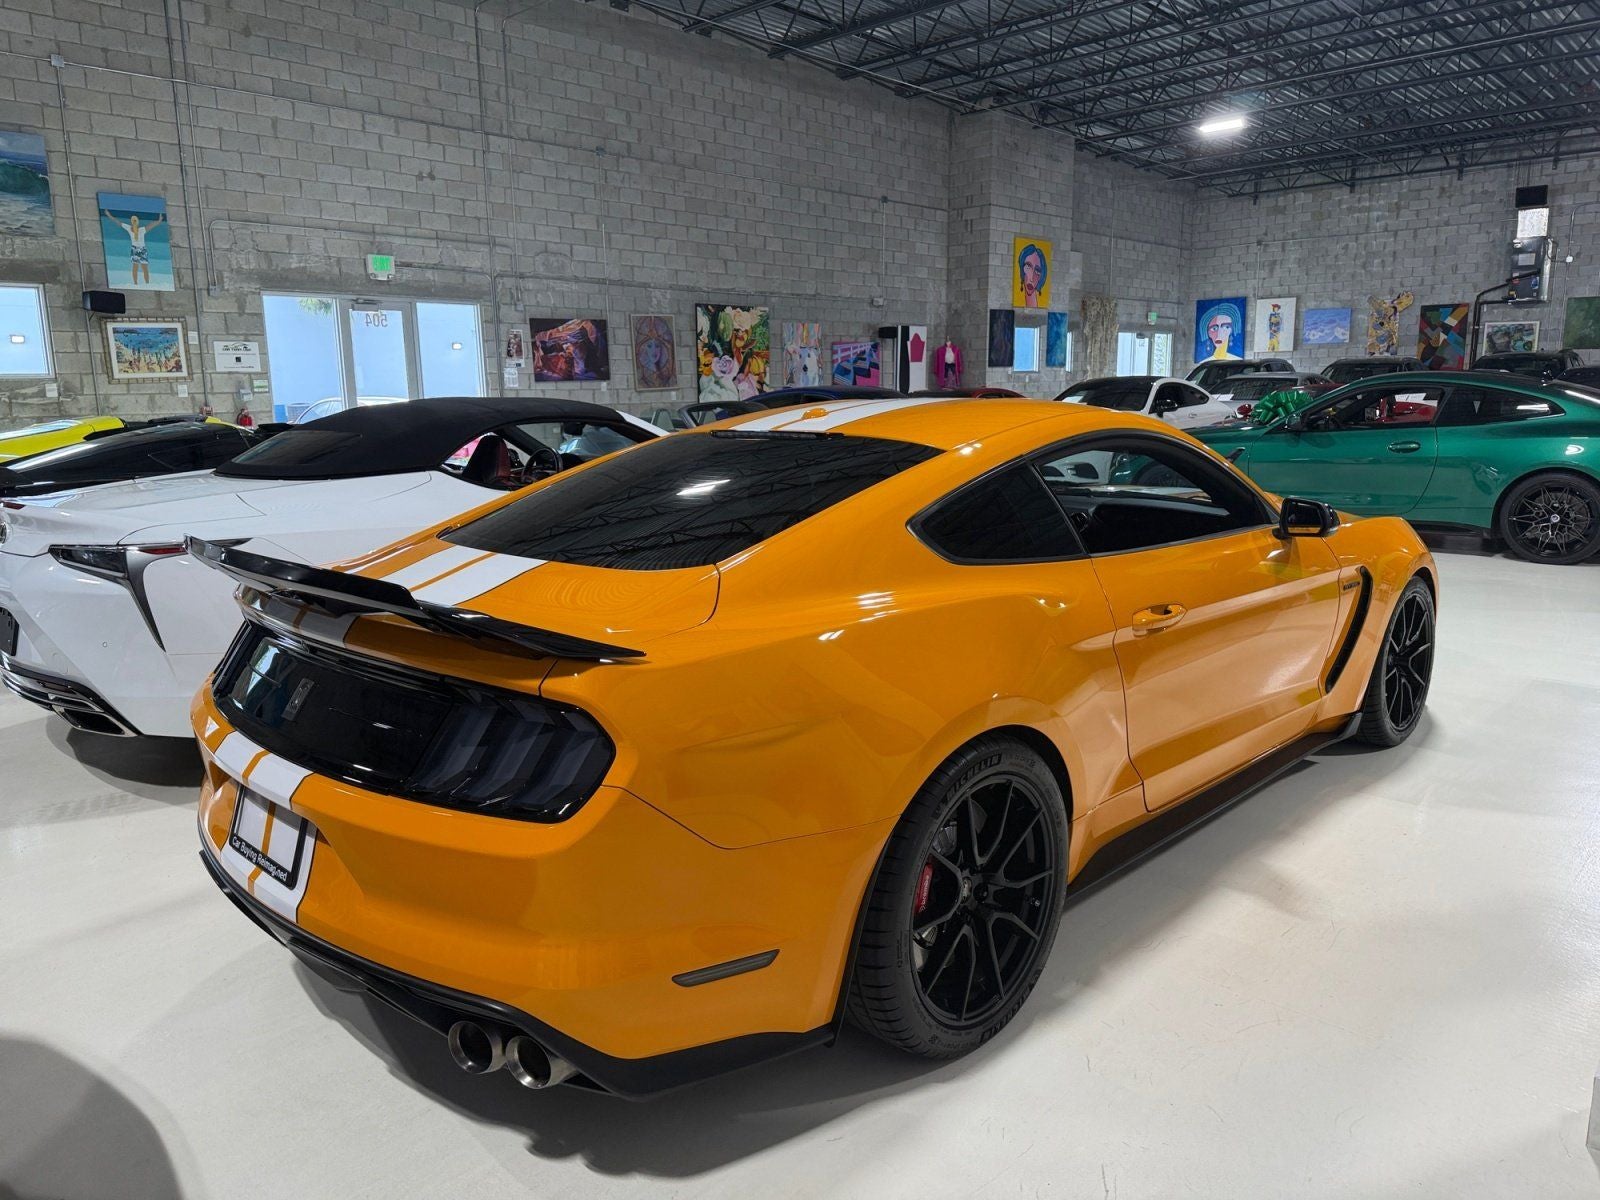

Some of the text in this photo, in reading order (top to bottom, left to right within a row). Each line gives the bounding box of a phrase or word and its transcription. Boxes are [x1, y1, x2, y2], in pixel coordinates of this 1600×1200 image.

[946, 752, 1003, 801] MICHELIN
[232, 836, 241, 849] Car
[240, 841, 257, 863] Buying
